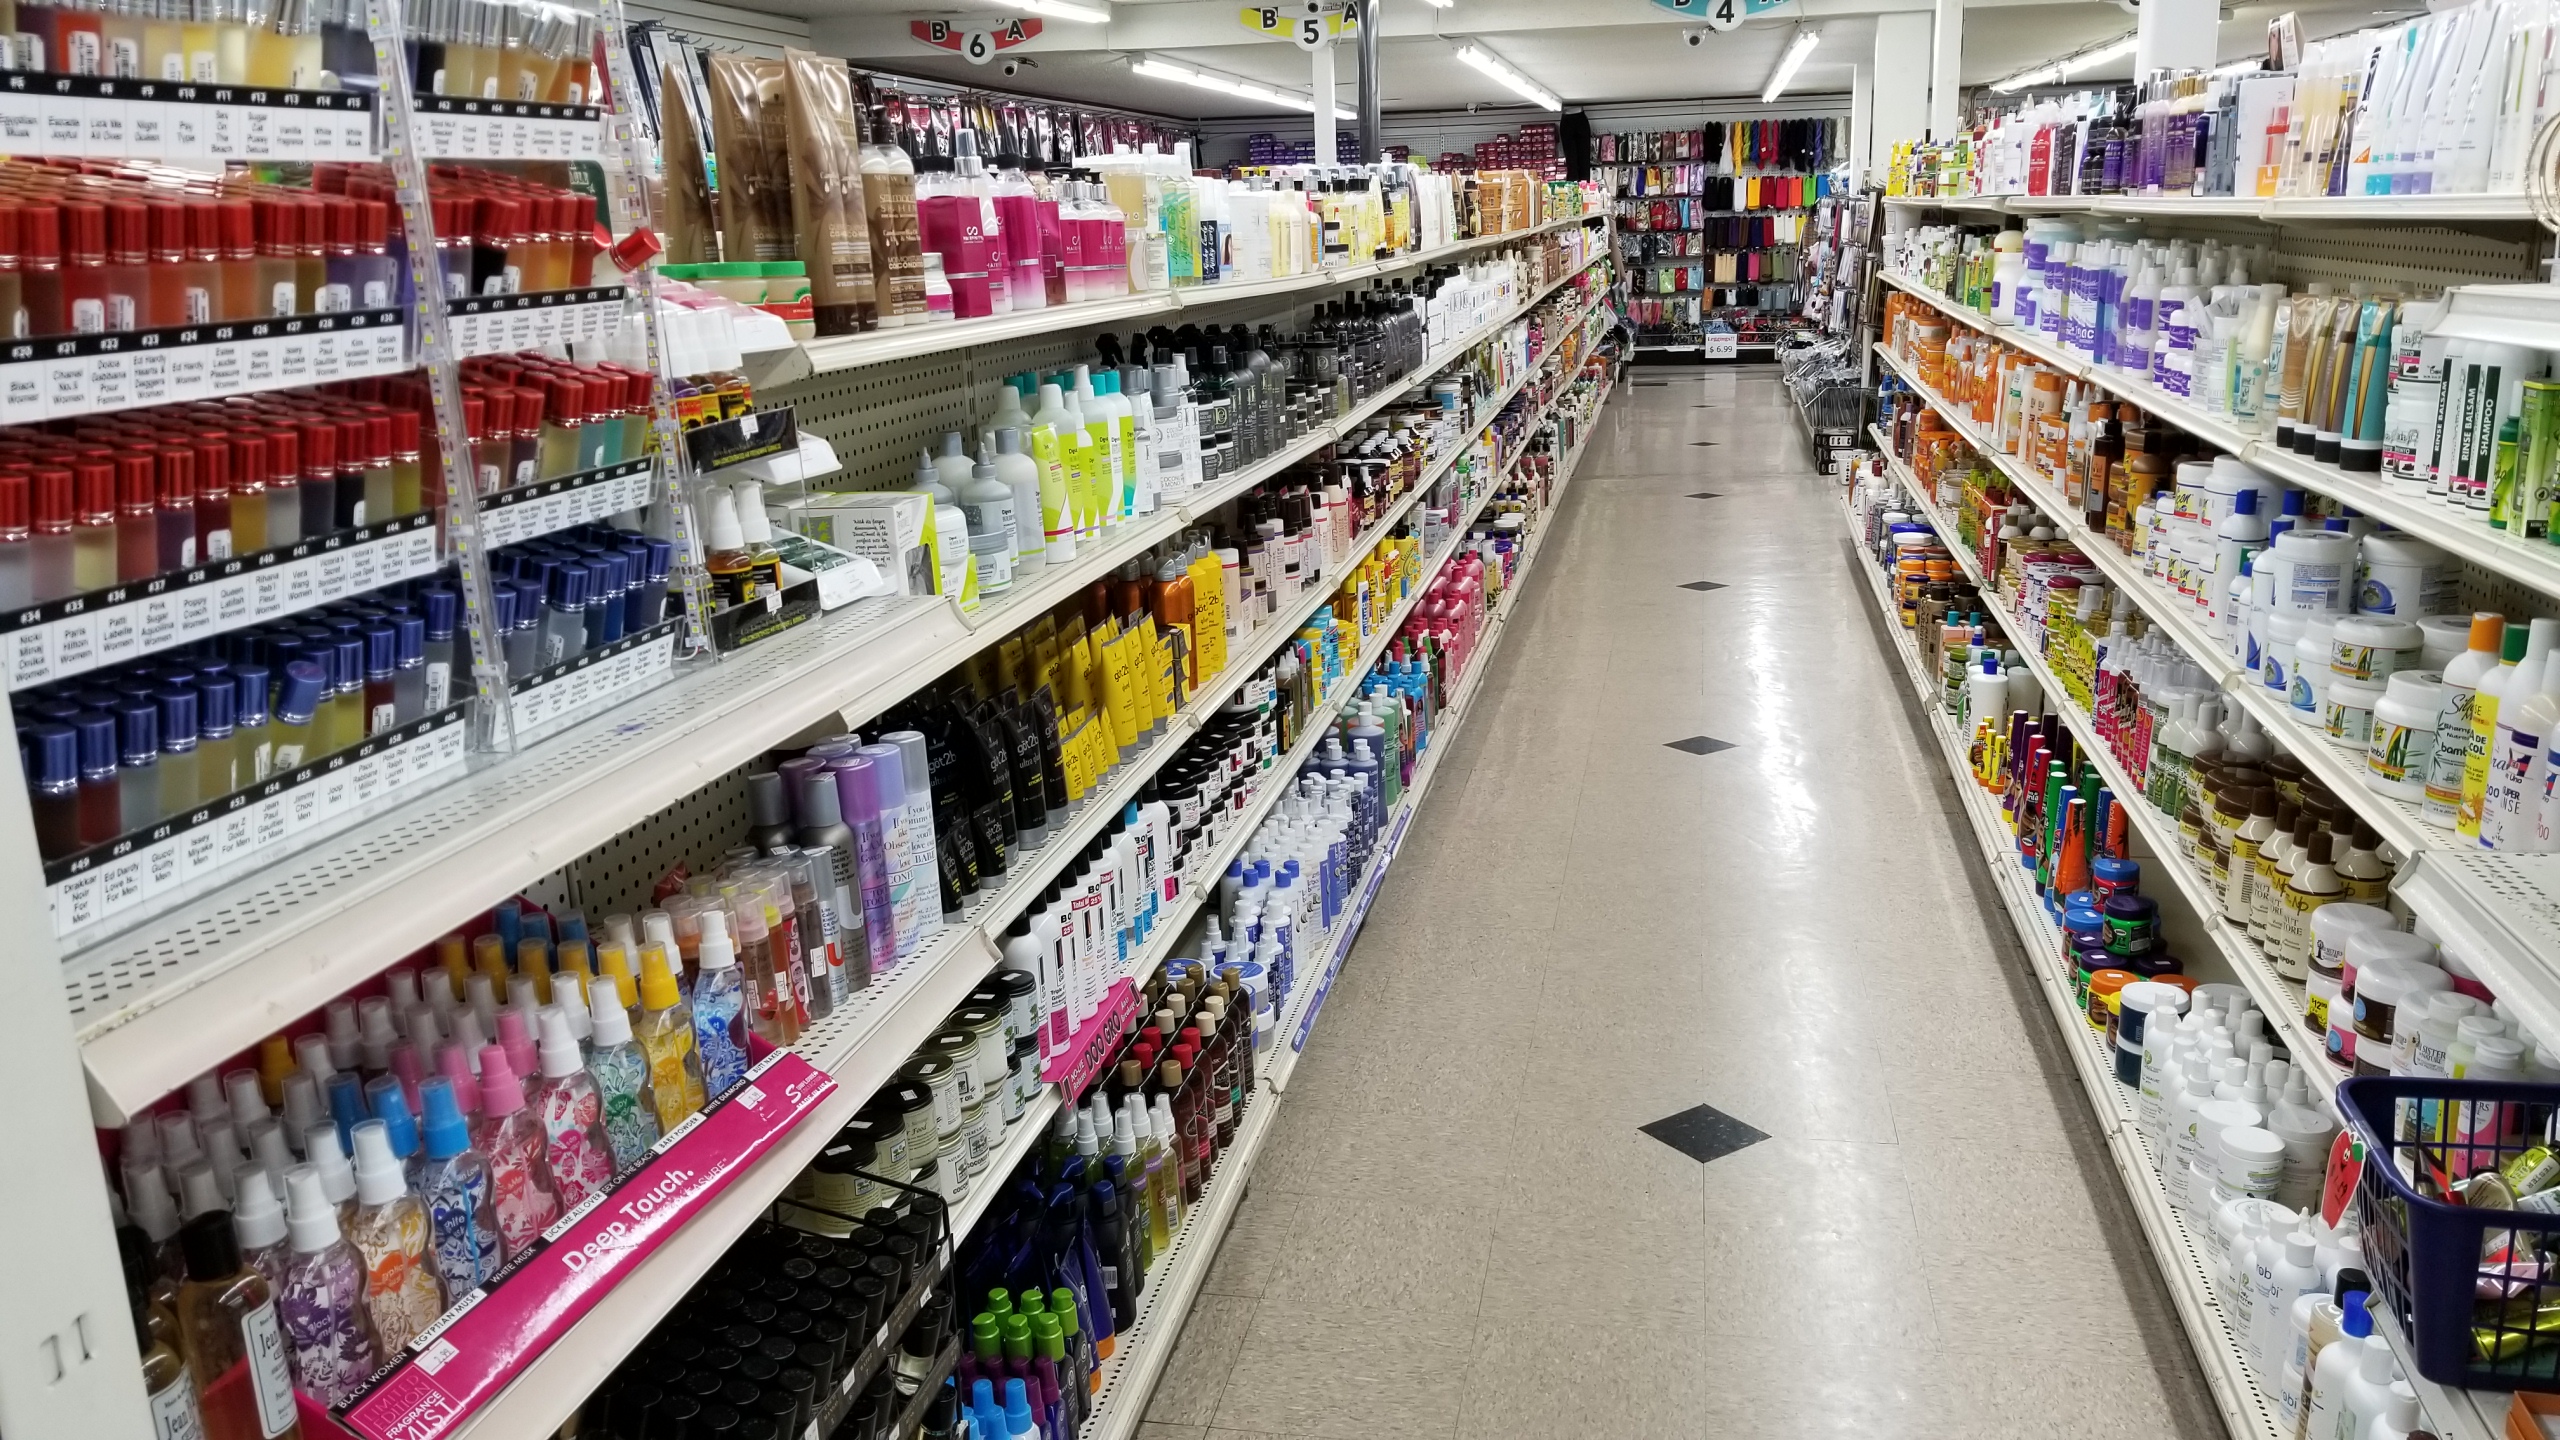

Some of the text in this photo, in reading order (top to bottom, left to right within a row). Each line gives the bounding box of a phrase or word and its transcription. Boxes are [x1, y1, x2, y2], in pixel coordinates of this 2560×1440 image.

[1715, 0, 1735, 23] 4
[1261, 1, 1359, 44] B 5 A
[931, 19, 1026, 58] B 6 A
[319, 317, 334, 329] #28
[351, 314, 365, 326] #29
[379, 312, 394, 323] #30
[286, 320, 302, 332] #27
[1716, 345, 1733, 353] 6.99
[2433, 380, 2449, 453] RINSE BALSAM
[2461, 387, 2478, 462] RINSE BALSAM
[2479, 398, 2495, 457] SHAMPOO
[413, 515, 427, 526] #45
[386, 522, 400, 533] #44
[355, 530, 369, 541] #43
[325, 537, 340, 549] #42
[293, 545, 308, 557] #41
[292, 569, 308, 579] Vera
[291, 579, 310, 591] Wang
[288, 588, 313, 601] Women
[444, 711, 457, 723] #60
[418, 721, 432, 733] #59
[388, 733, 402, 745] #58
[359, 744, 374, 757] #57
[414, 741, 431, 753] Prada
[329, 756, 343, 769] #56
[411, 749, 434, 764] Extreme
[358, 761, 373, 773] Paco
[386, 758, 403, 770] Ralph
[296, 768, 311, 782] #55
[264, 781, 281, 796] #54
[327, 783, 344, 796] Joop
[230, 795, 246, 809] #53
[293, 790, 316, 804] Jimmy
[329, 793, 342, 804] Men
[263, 800, 280, 812] Jean
[295, 801, 313, 813] Choo
[264, 810, 279, 822] Paul
[297, 811, 311, 822] Men
[1084, 1009, 1122, 1070] DOO GRO
[752, 1049, 782, 1074] BUTT NAKED
[702, 1078, 747, 1115] WHITE DIAMOND
[658, 1116, 700, 1149] BABY POWDER
[602, 1150, 655, 1194] SEX ON THE BEACH
[546, 1193, 603, 1238] LICK ME ALL OVER
[562, 1170, 695, 1273] Deep Touch.
[490, 1246, 538, 1285] WHITE MUSK
[414, 1293, 479, 1346] EGYPTIAN MUSK
[337, 1350, 408, 1409] BLACK WOMEN
[363, 1374, 420, 1422] LIMITED
[373, 1381, 432, 1431] EDITION
[385, 1390, 442, 1439] FRAGRANCE
